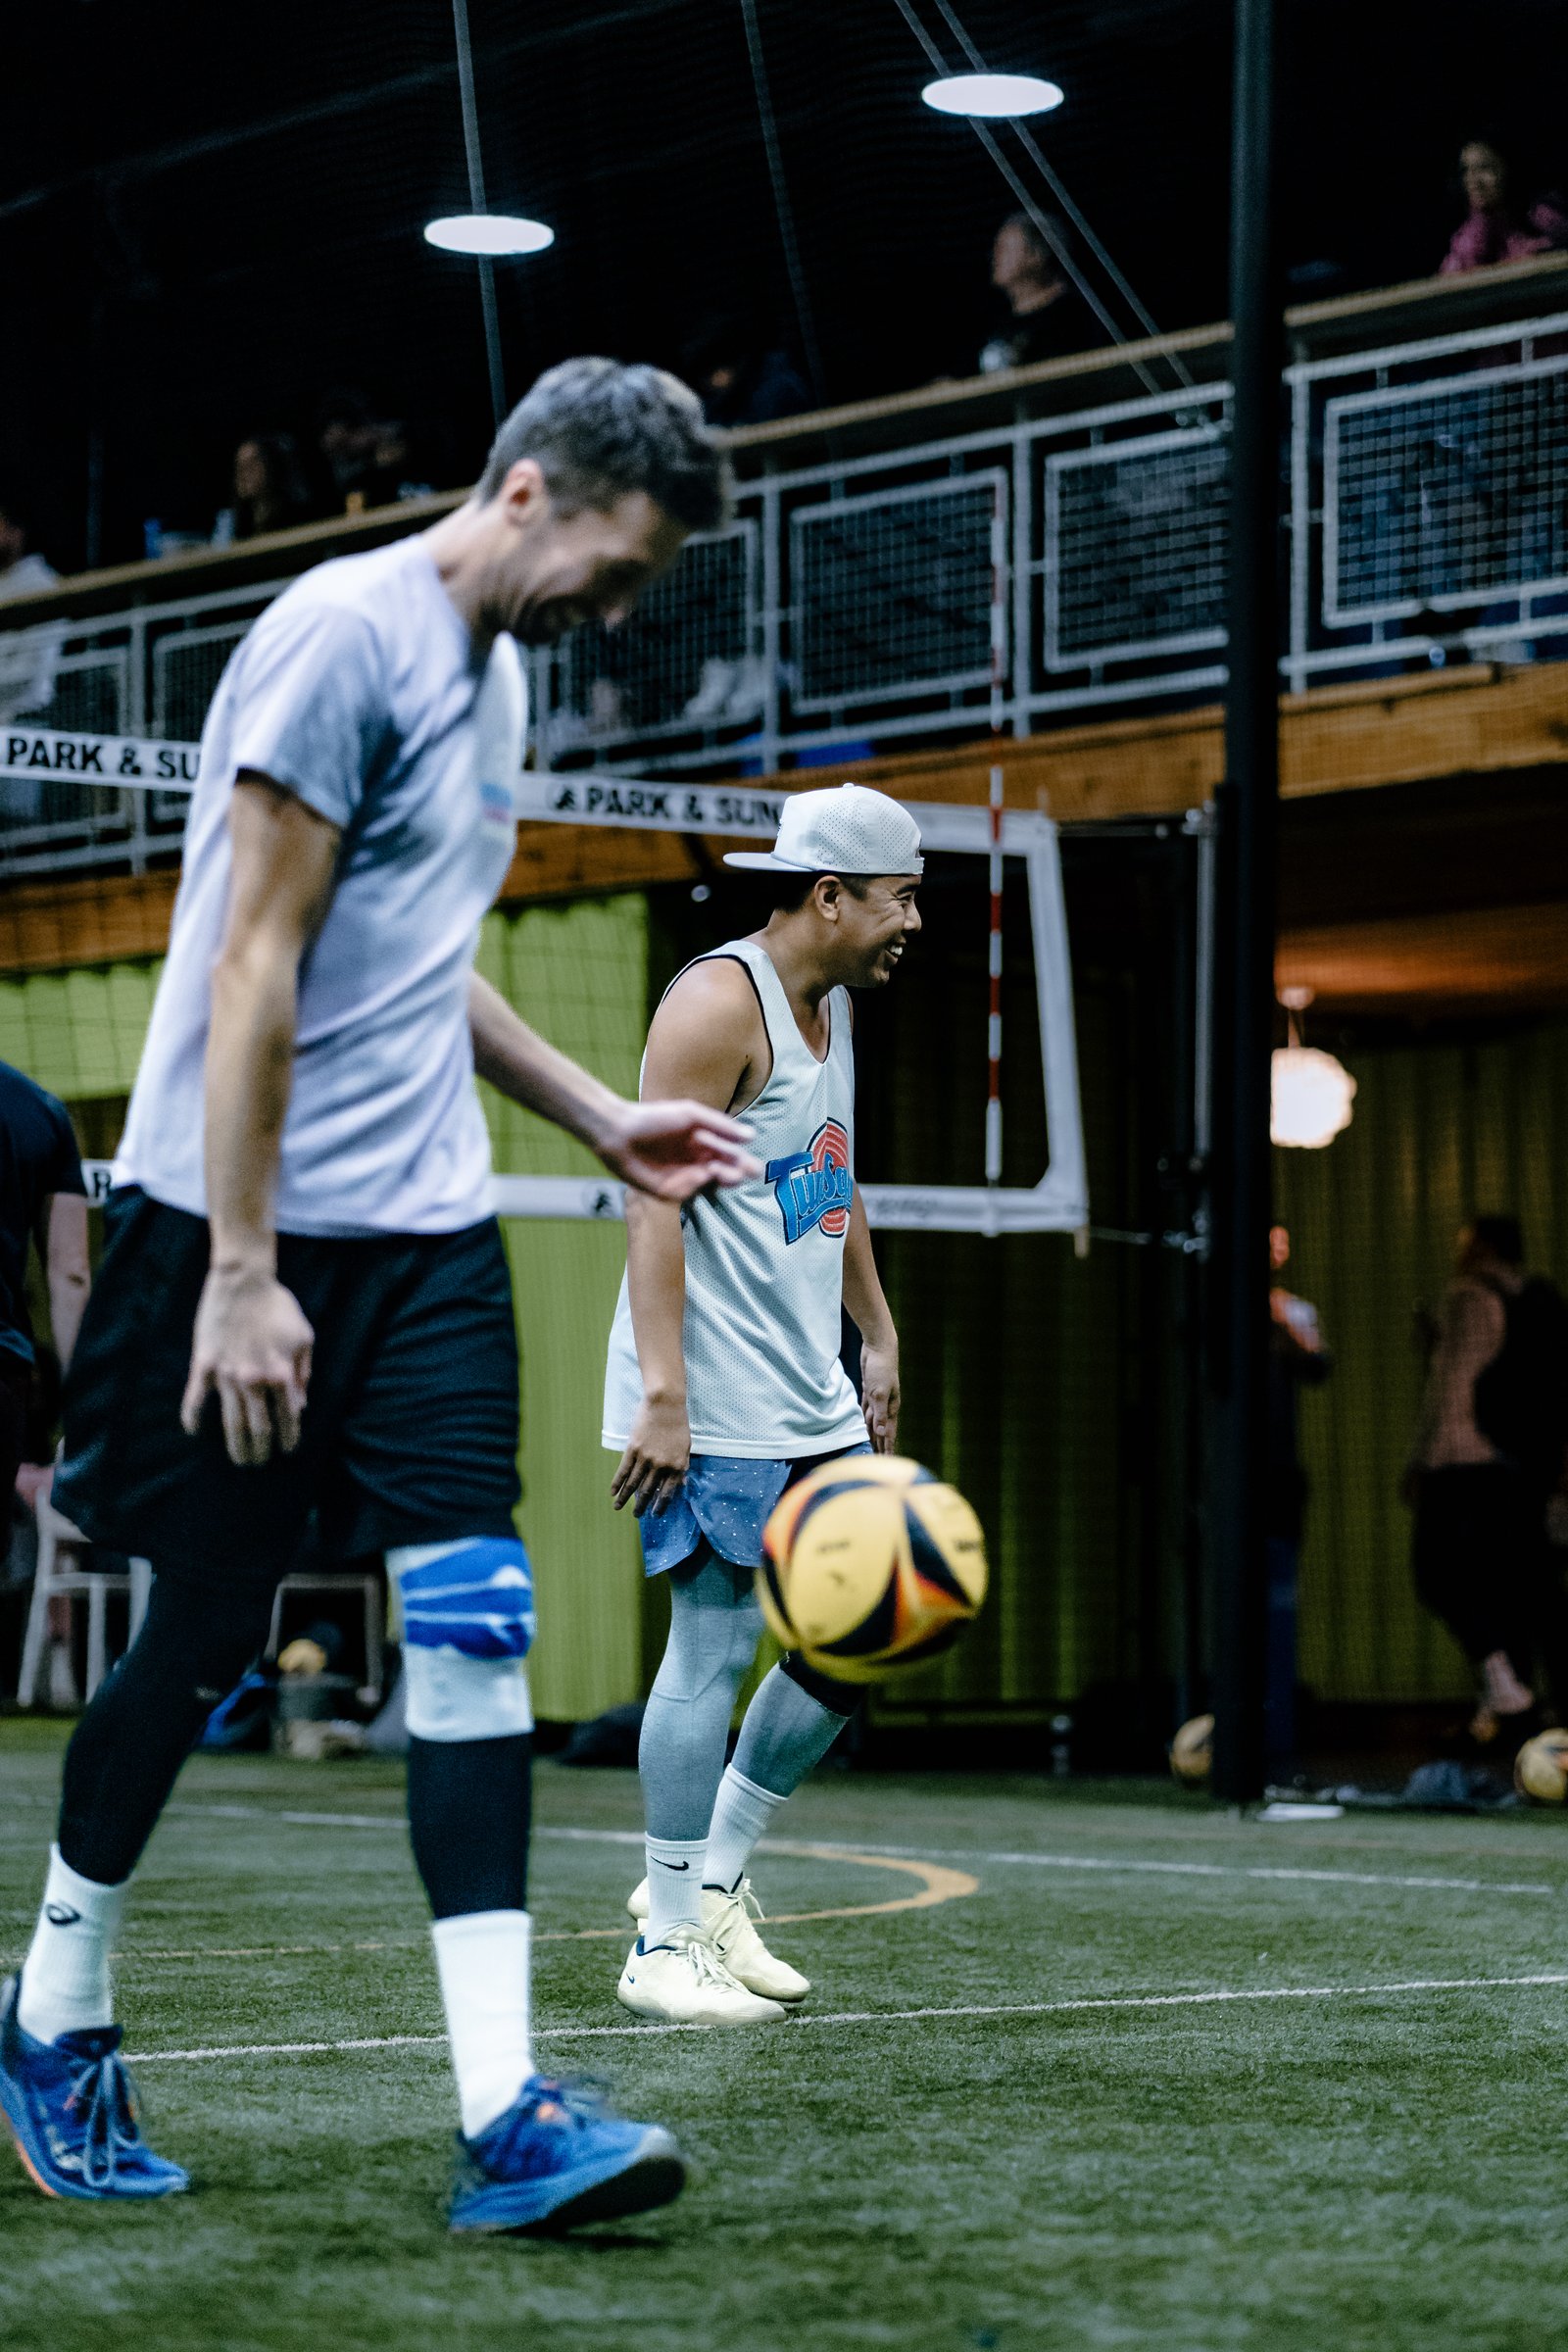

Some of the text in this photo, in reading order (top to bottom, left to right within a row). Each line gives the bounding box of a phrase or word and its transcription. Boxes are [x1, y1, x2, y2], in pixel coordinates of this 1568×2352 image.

[8, 738, 200, 780] PARK & SU
[587, 786, 781, 825] PARK & SUN
